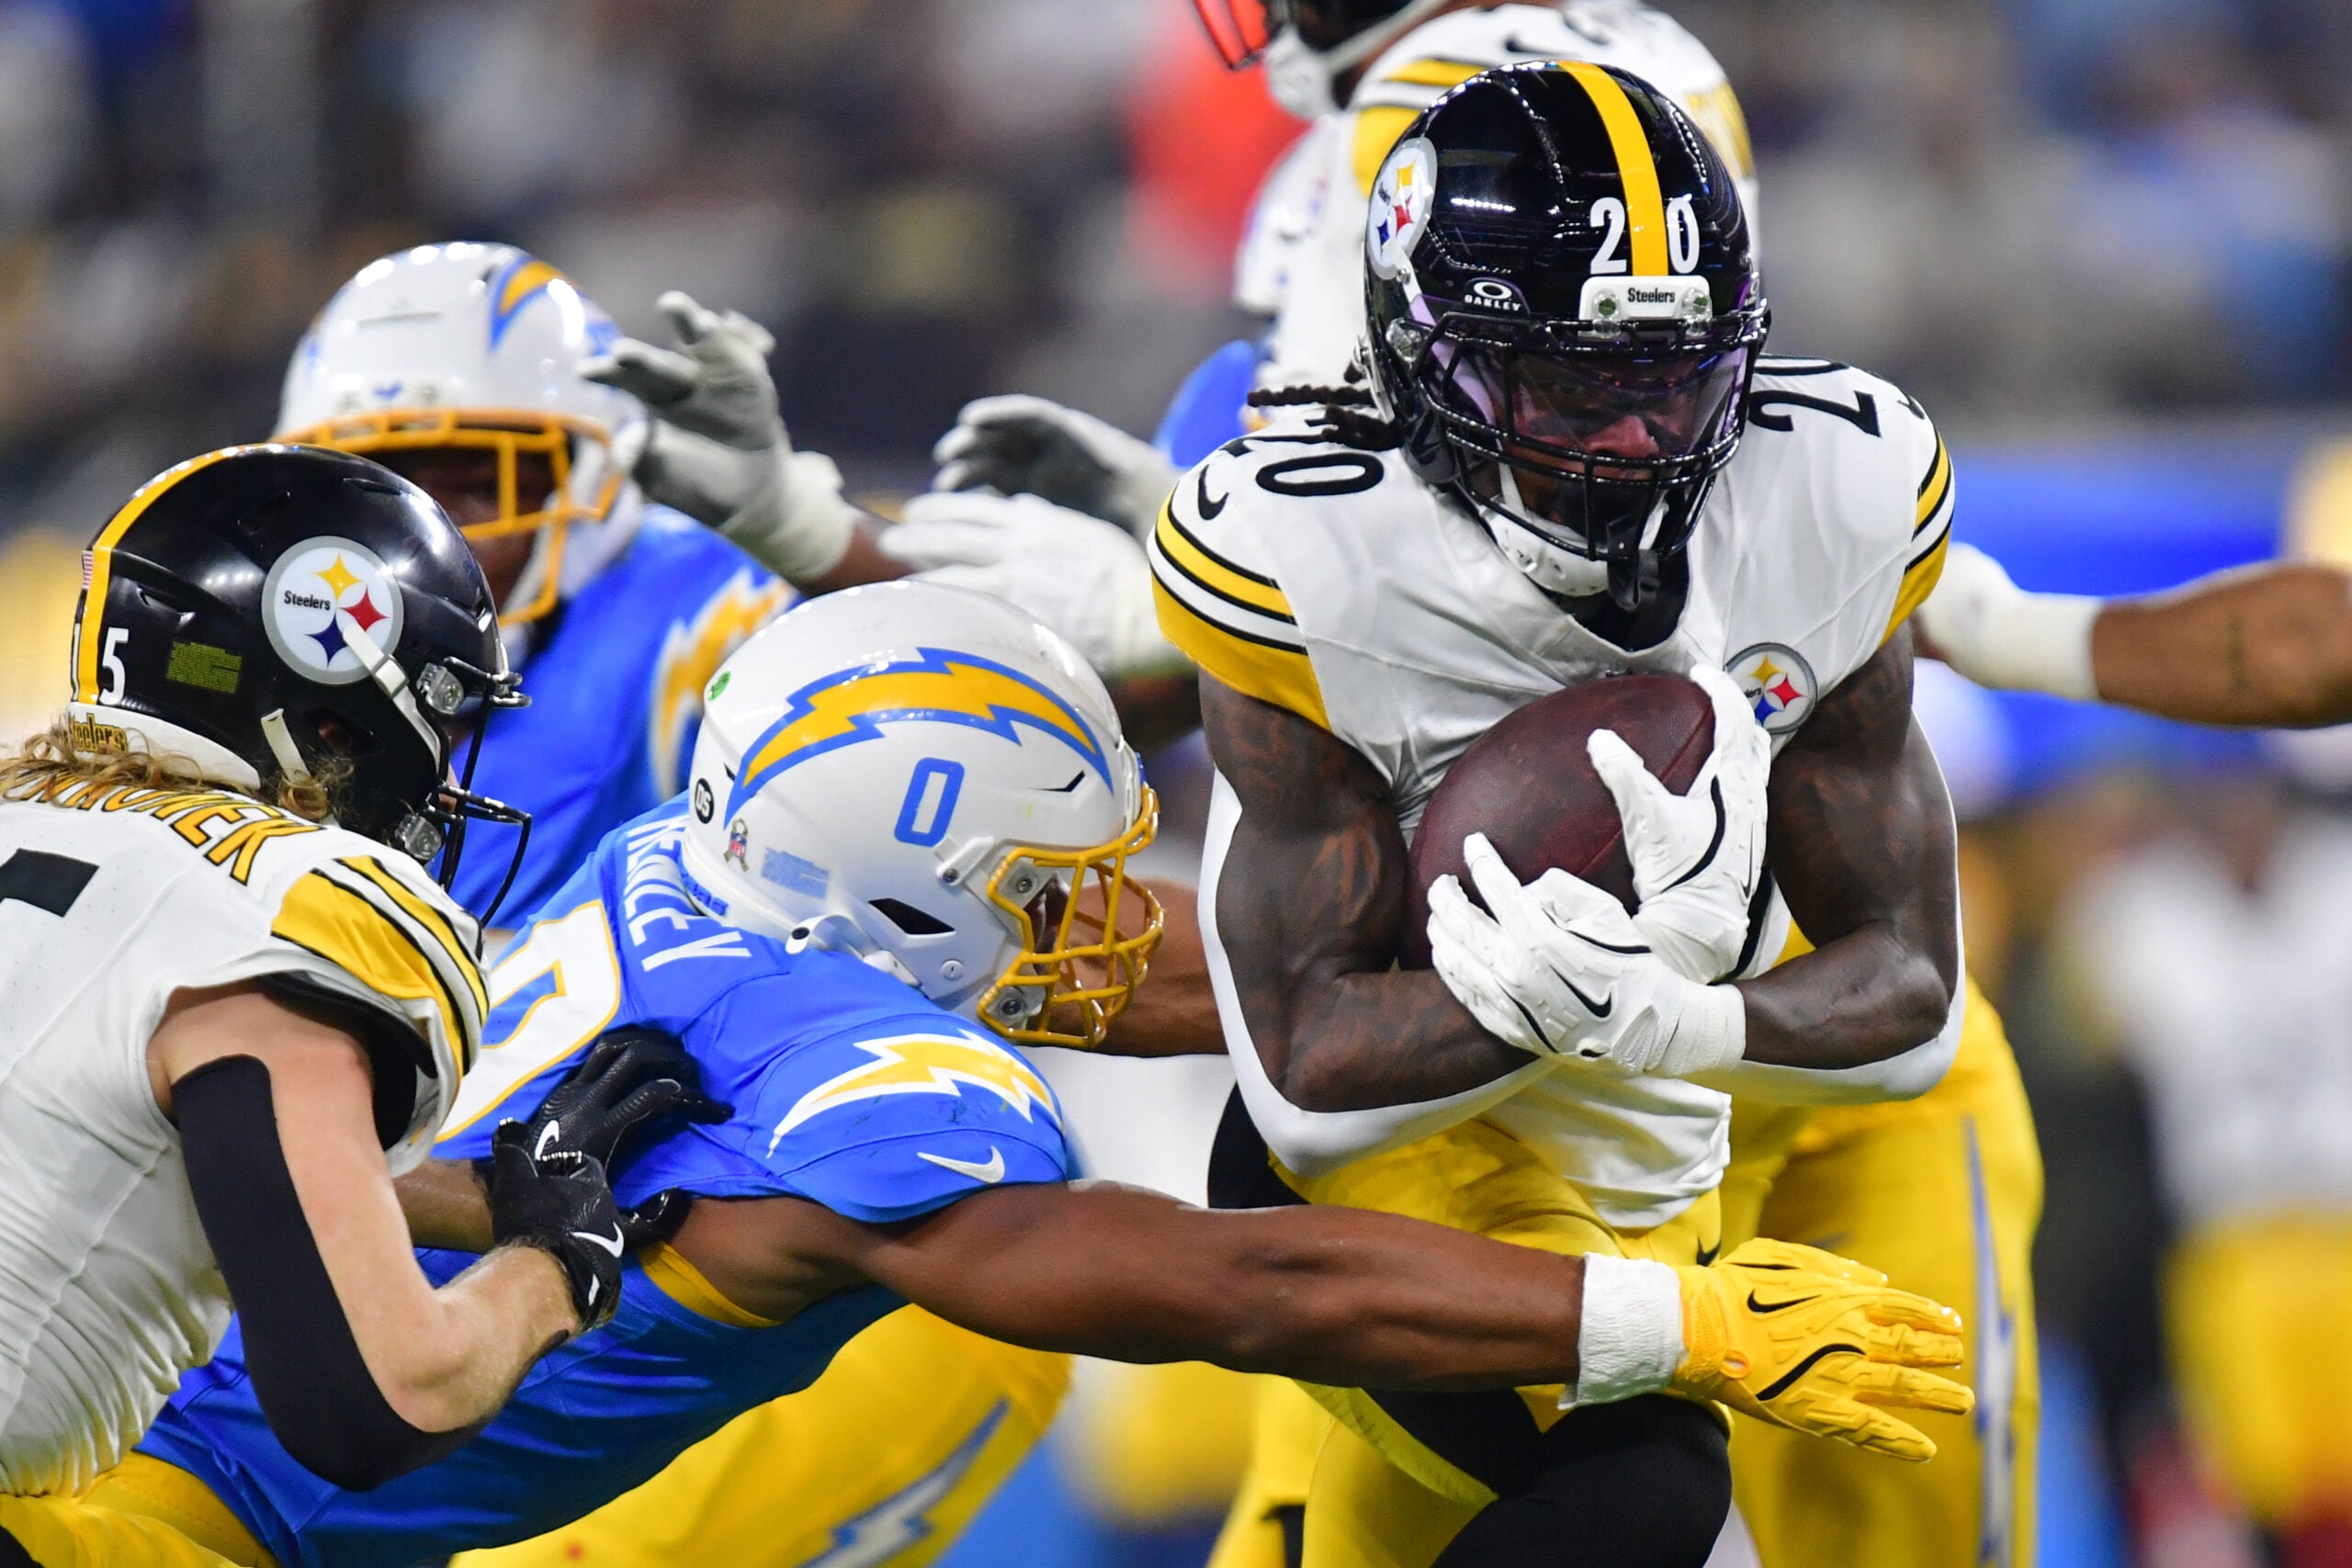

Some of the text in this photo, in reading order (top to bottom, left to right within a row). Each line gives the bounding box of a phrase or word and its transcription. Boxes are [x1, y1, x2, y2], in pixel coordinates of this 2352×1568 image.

[1589, 196, 1700, 274] 20
[1464, 294, 1521, 311] OAKLEY
[1627, 288, 1676, 303] Steelers
[284, 590, 332, 611] Steelers
[894, 757, 965, 848] 0
